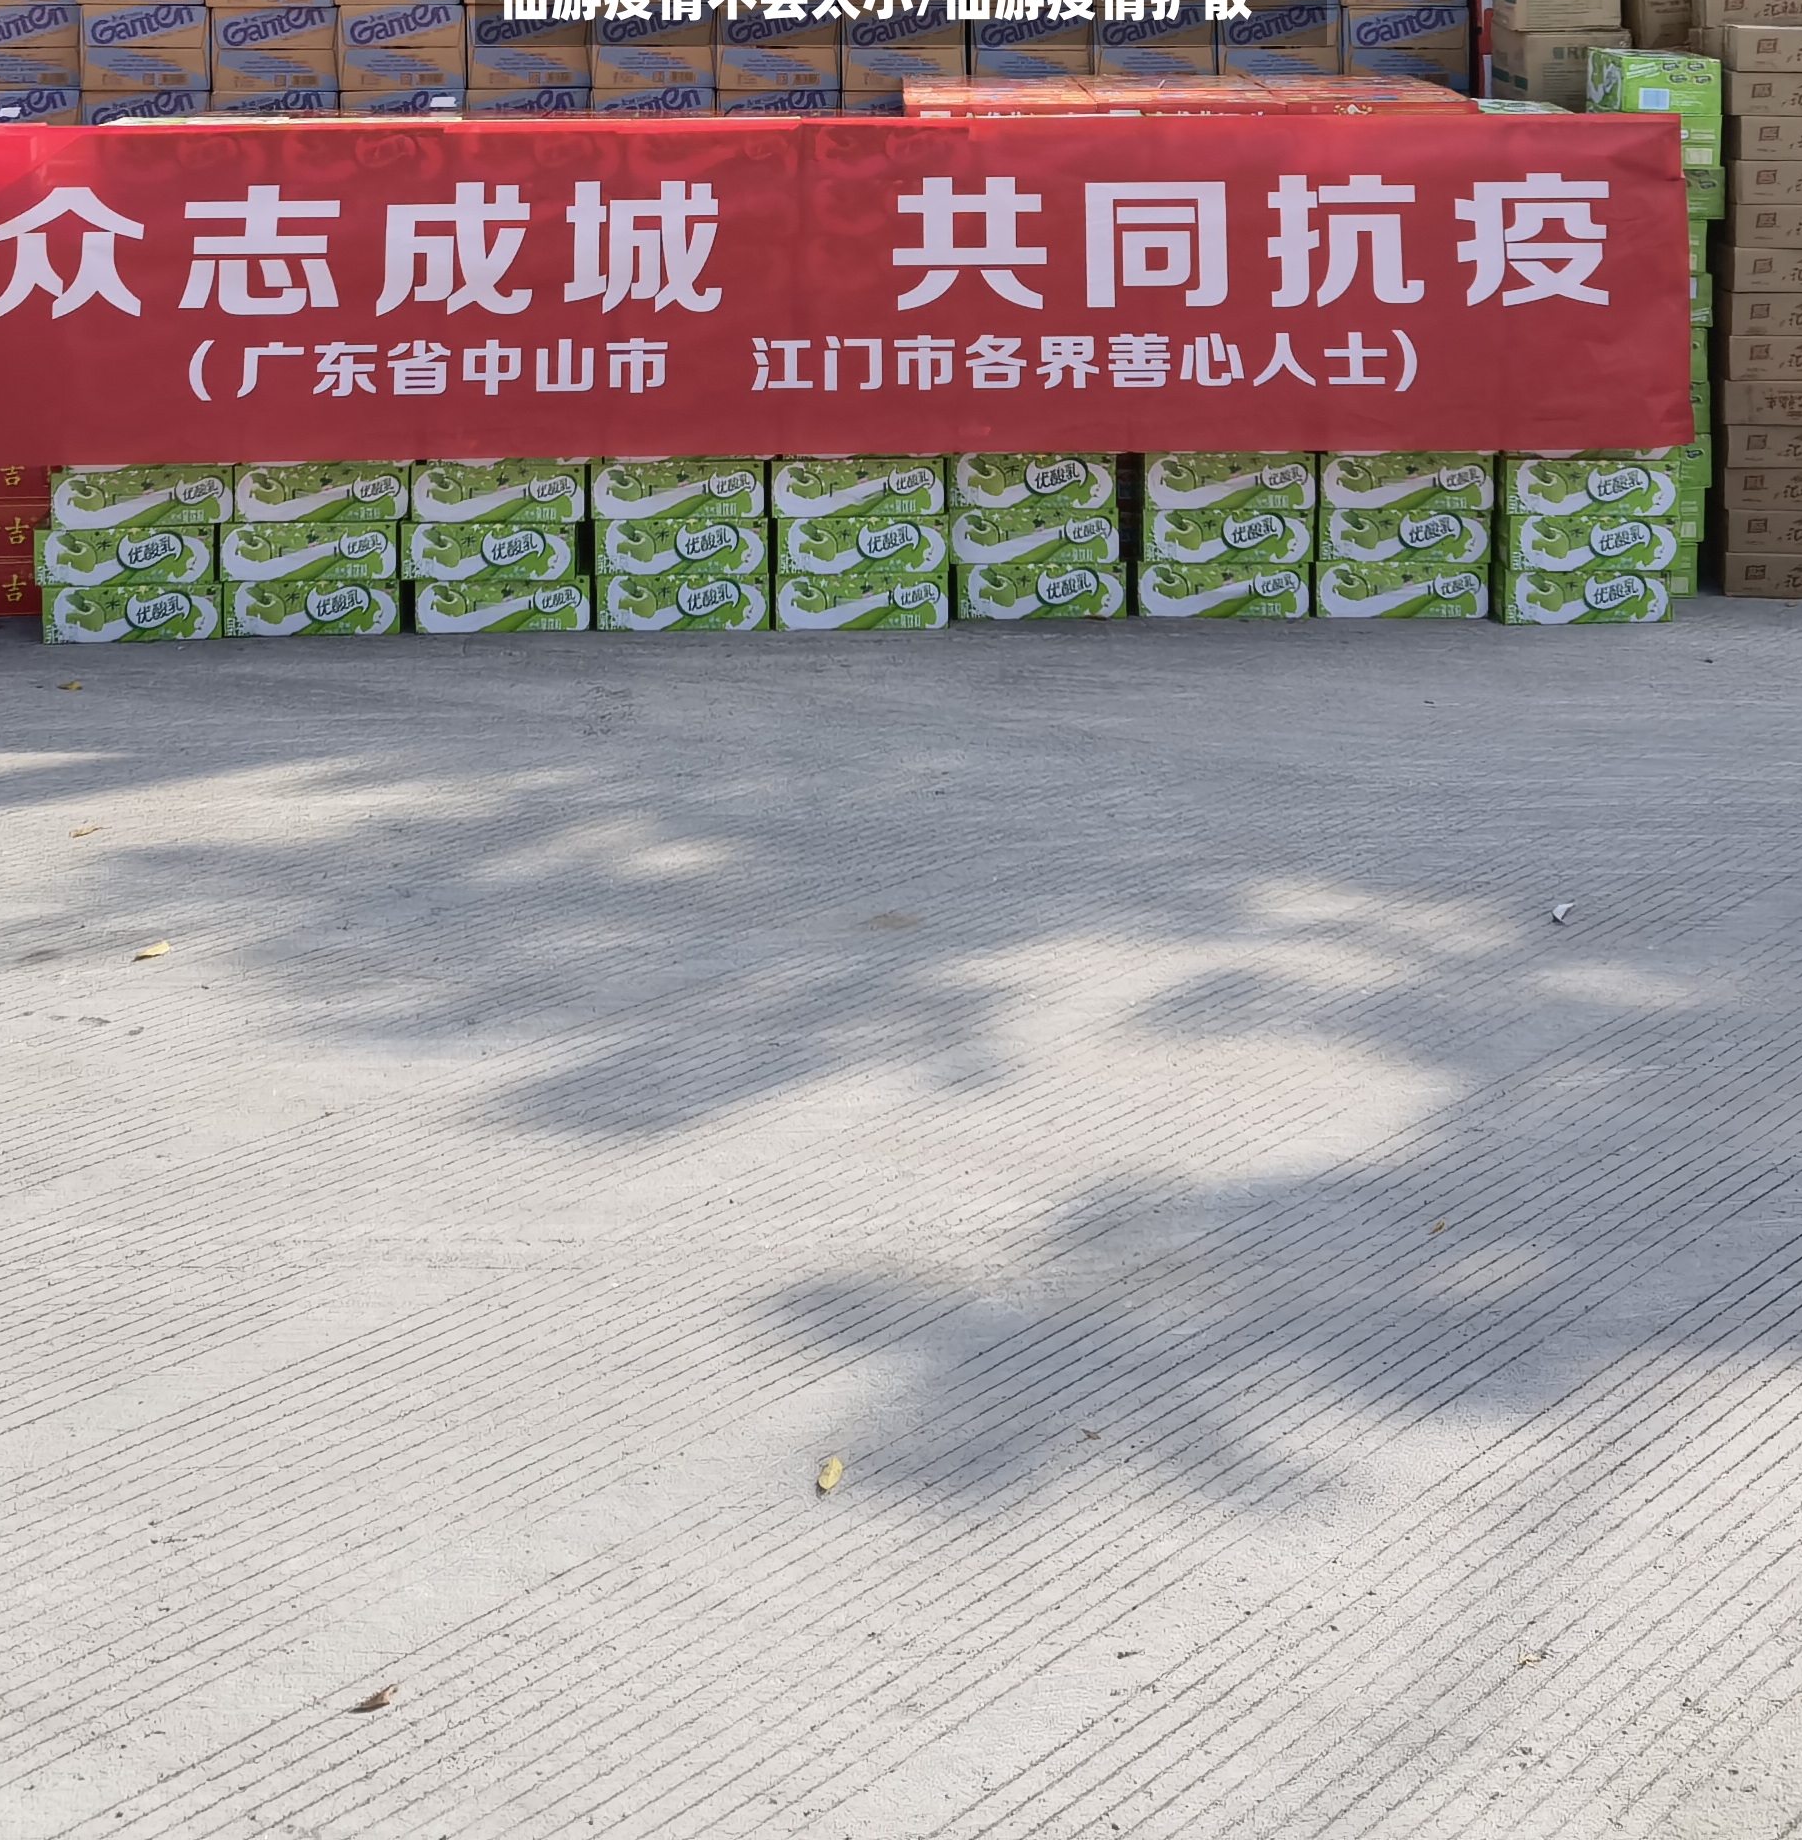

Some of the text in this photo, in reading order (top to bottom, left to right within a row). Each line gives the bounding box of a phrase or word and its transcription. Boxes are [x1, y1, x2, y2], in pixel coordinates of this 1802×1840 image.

[91, 5, 196, 47] Ganten
[349, 4, 453, 46] Ganten
[1353, 9, 1452, 48] Ganten
[892, 172, 1610, 310] 共同抗疫
[190, 338, 670, 401] (广东省中山市
[751, 329, 1418, 392] 江门市各界善心人士)
[181, 480, 219, 501] 优酸乳
[359, 476, 395, 499] 优酸乳
[537, 475, 572, 498] 优酸乳
[715, 471, 751, 494] 优酸乳
[896, 468, 930, 491] 优酸乳
[1034, 464, 1081, 491] 优酸乳
[1598, 469, 1644, 497] 优酸乳
[685, 528, 731, 554] 优酸乳
[867, 525, 912, 553] 优酸乳
[1072, 519, 1107, 541] 优酸乳
[1231, 517, 1278, 544] 优酸乳
[1409, 516, 1456, 543] 优酸乳
[1599, 522, 1644, 551] 优酸乳
[128, 535, 176, 564] 优酸乳
[347, 533, 382, 555] 优酸乳
[492, 533, 538, 560] 优酸乳
[541, 586, 577, 609] 优酸乳
[687, 584, 732, 611] 优酸乳
[901, 583, 935, 606] 优酸乳
[1046, 574, 1092, 601] 优酸乳
[1260, 573, 1296, 596] 优酸乳
[1594, 577, 1640, 605] 优酸乳
[136, 596, 184, 624] 优酸乳
[316, 589, 363, 615] 优酸乳
